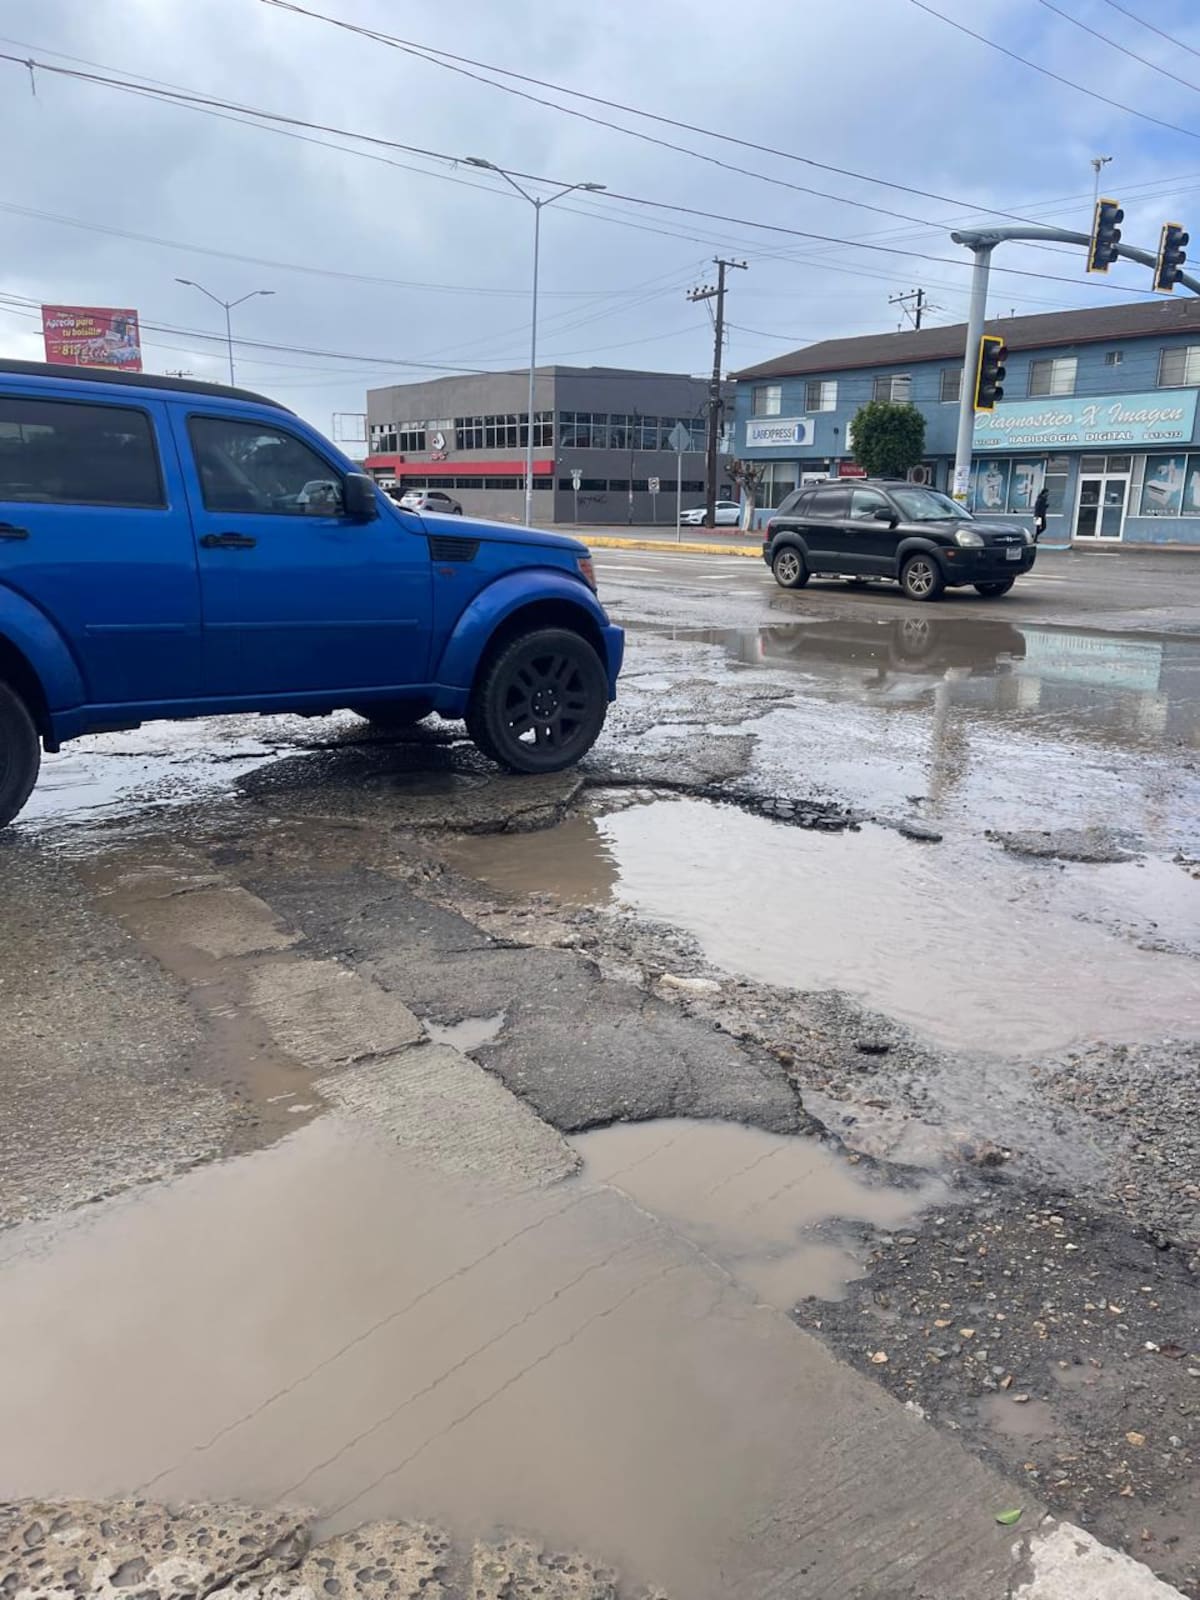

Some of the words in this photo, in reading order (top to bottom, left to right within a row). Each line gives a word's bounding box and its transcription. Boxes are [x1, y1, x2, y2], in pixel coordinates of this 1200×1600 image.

[973, 410, 1074, 432] Diagnostico
[1078, 404, 1101, 427] X
[1107, 402, 1183, 428] Imagen
[1008, 433, 1078, 445] RADIOLOGIA
[1085, 431, 1133, 441] DIGITAL
